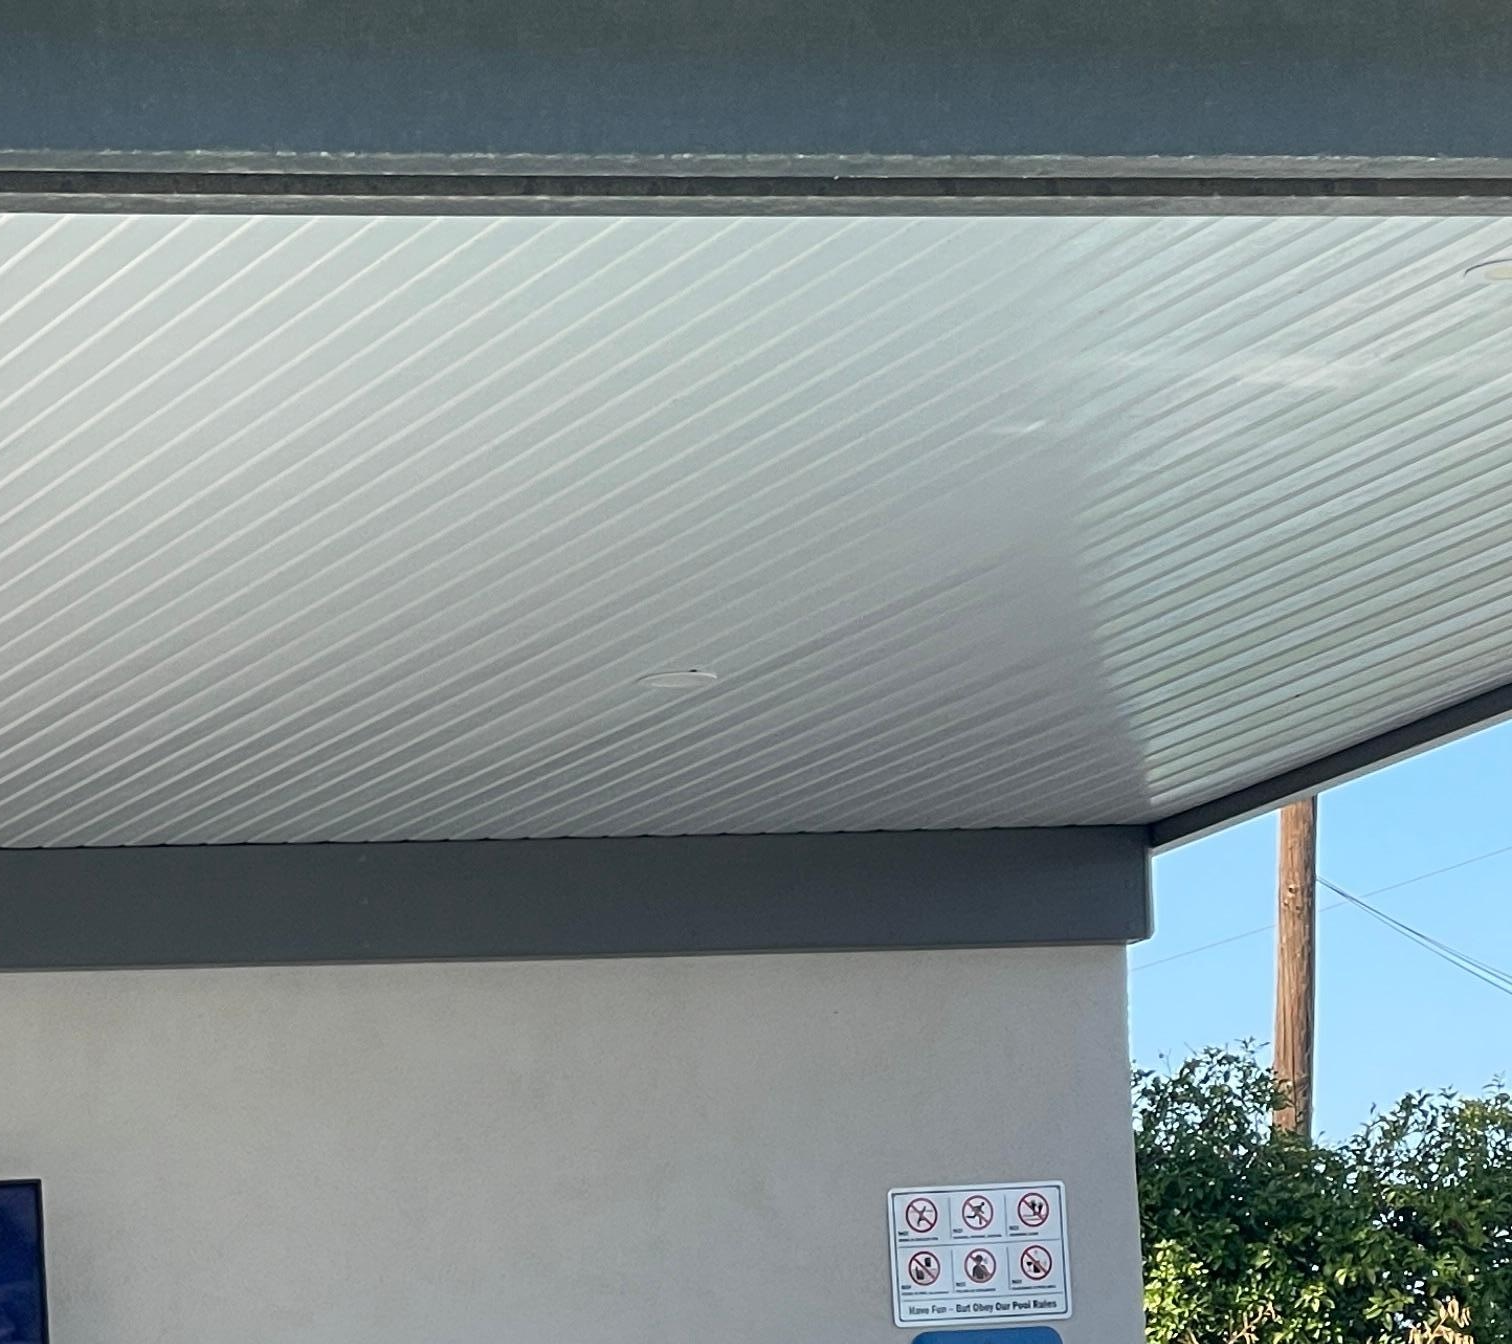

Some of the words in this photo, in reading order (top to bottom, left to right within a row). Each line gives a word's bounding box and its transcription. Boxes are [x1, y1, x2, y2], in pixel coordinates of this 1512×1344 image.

[995, 1302, 1010, 1311] Our
[1012, 1300, 1031, 1310] Pool
[1033, 1299, 1057, 1309] Rules
